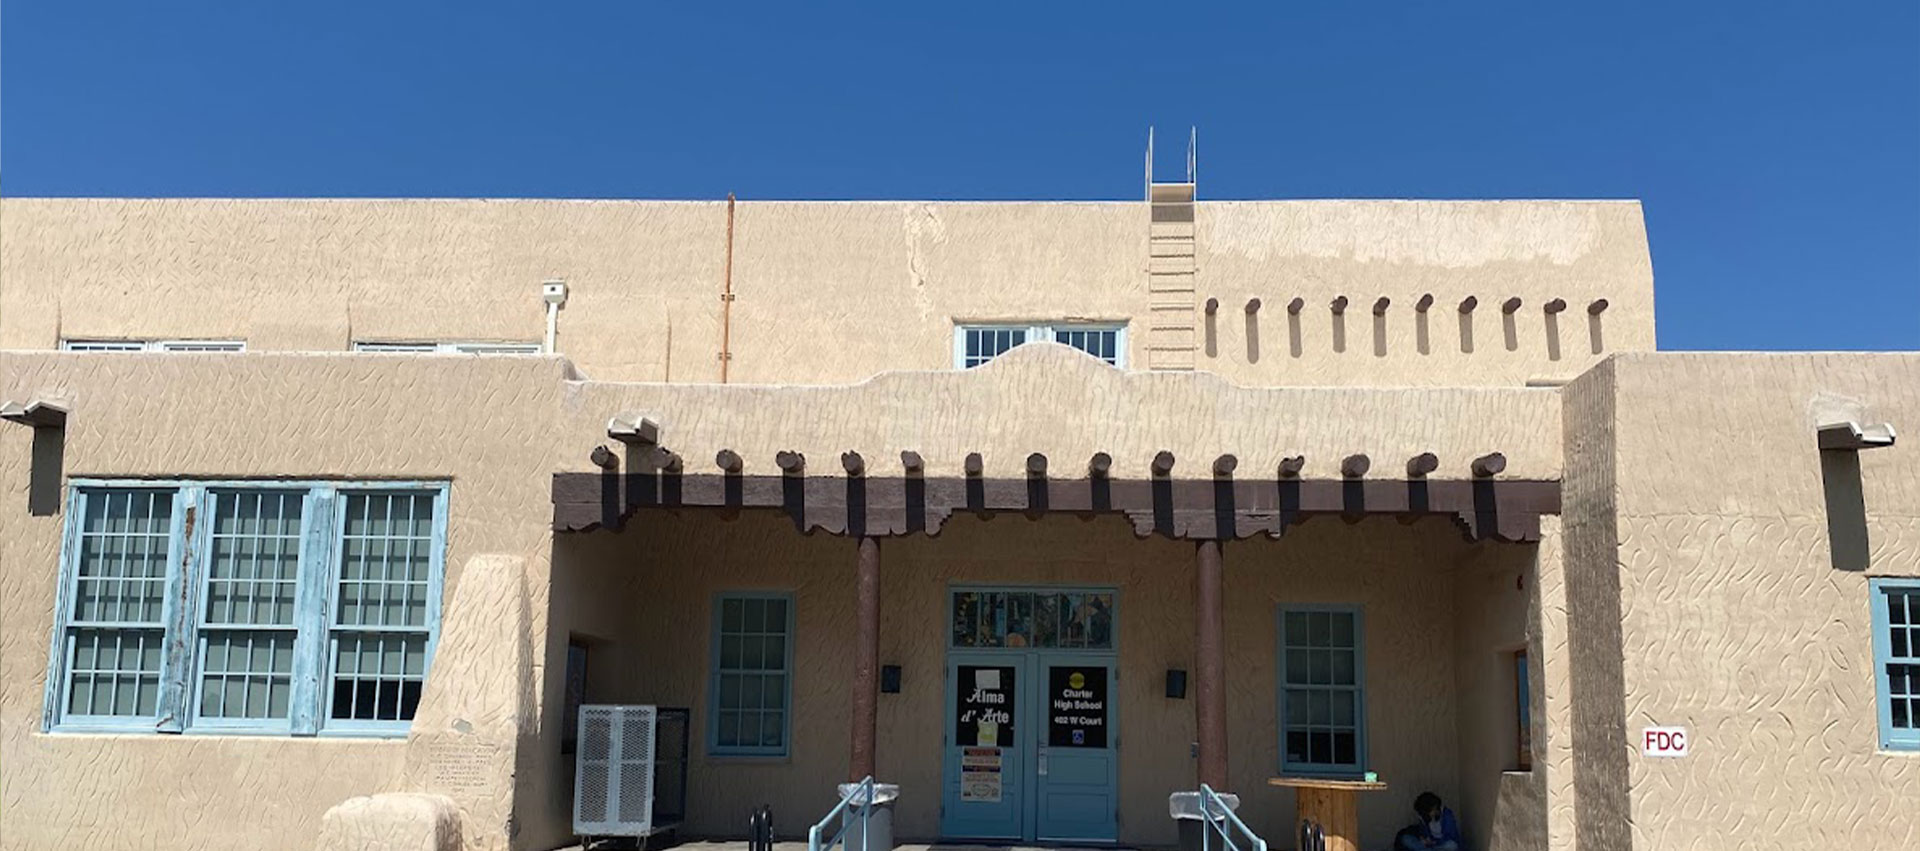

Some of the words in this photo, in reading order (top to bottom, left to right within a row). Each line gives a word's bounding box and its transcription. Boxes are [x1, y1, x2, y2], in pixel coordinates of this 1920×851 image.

[966, 687, 1005, 704] Alma
[1063, 689, 1093, 699] Charter
[1054, 700, 1073, 711] High
[1074, 700, 1102, 710] School
[977, 708, 1010, 724] Arte
[1070, 716, 1079, 725] W
[1079, 716, 1102, 726] Court
[1646, 731, 1685, 751] FDC
